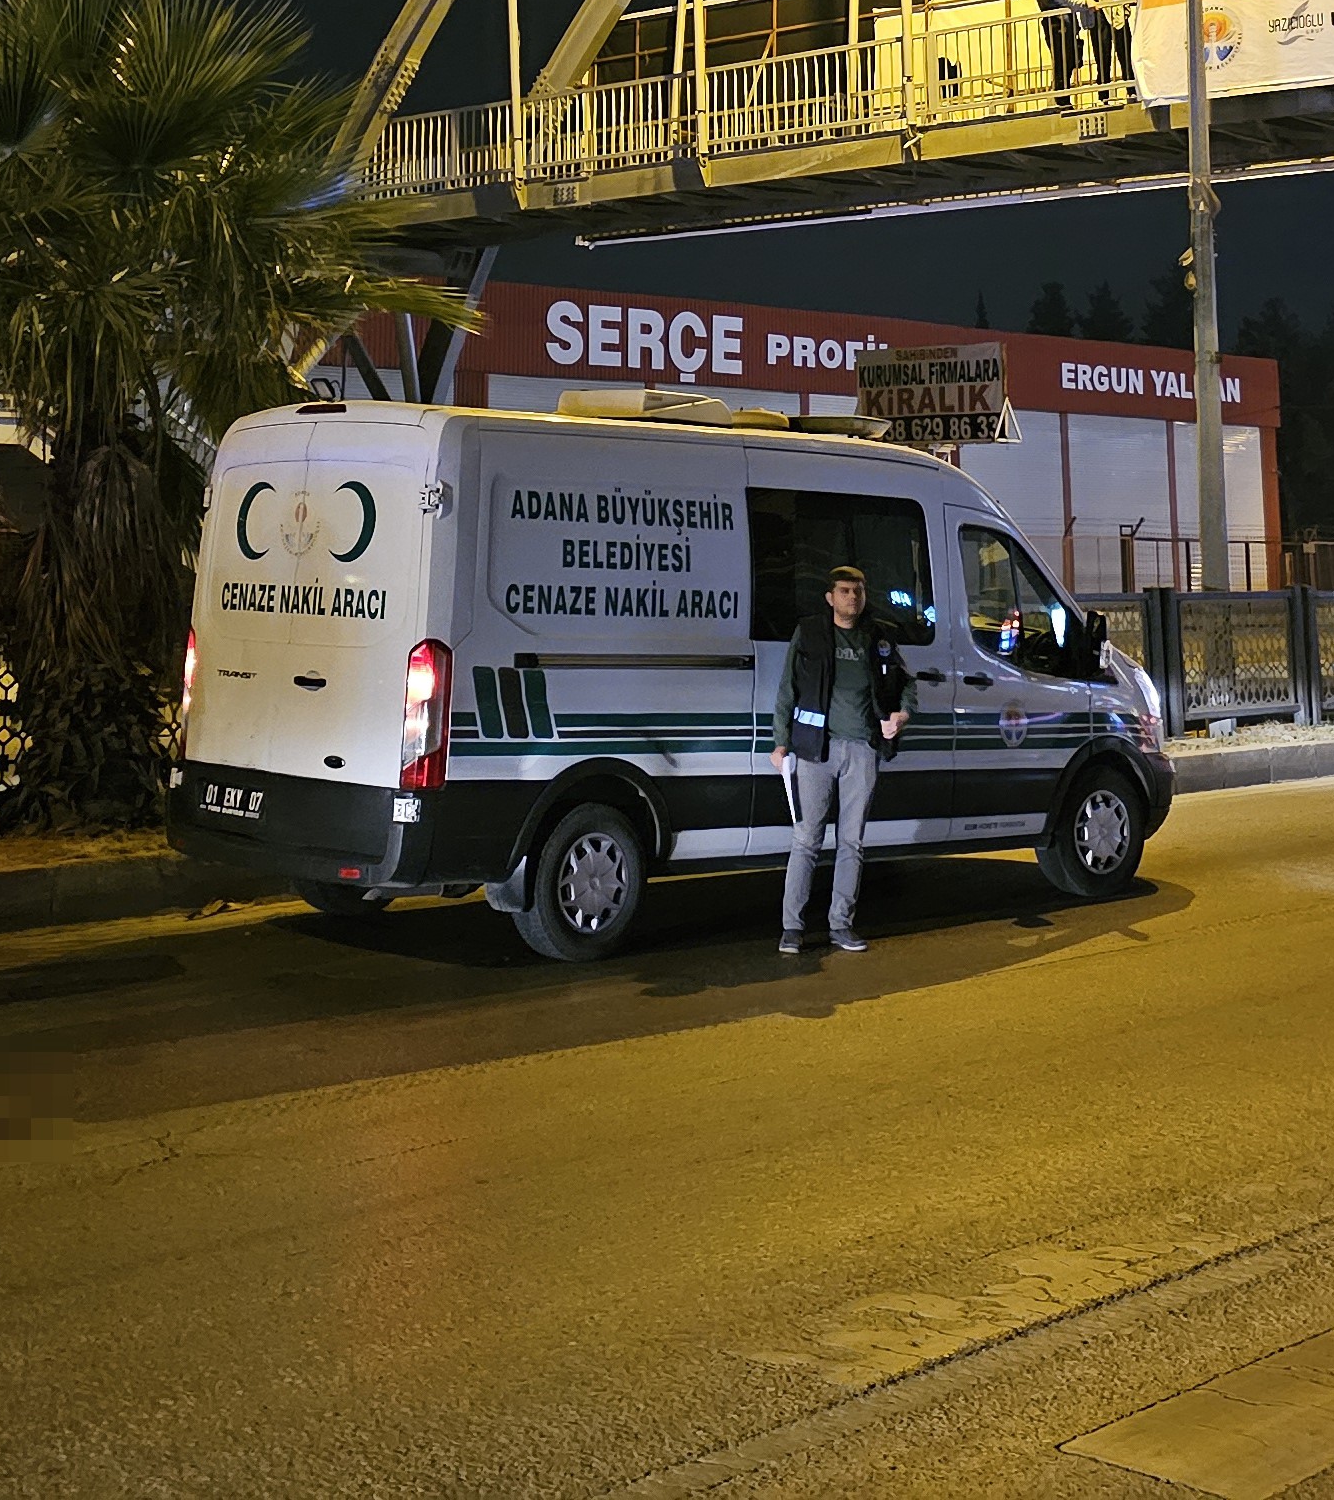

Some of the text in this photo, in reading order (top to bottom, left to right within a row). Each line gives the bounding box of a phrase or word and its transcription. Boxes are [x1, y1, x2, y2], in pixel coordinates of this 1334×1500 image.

[545, 300, 888, 383] SERÇE PROF
[859, 362, 925, 388] KURUMSAL
[1061, 362, 1241, 403] ERGUN YALN
[912, 417, 944, 441] 629
[949, 416, 971, 440] 86
[977, 415, 998, 439] 33
[510, 487, 734, 535] ADANA BÜYÜKŞEHİR
[562, 534, 691, 572] BELEDİYESİ
[221, 577, 386, 620] CENAZE NAKİL ARACI
[505, 580, 738, 619] CENAZE NAKİL ARACI
[206, 784, 218, 804] 01
[249, 791, 263, 811] 07
